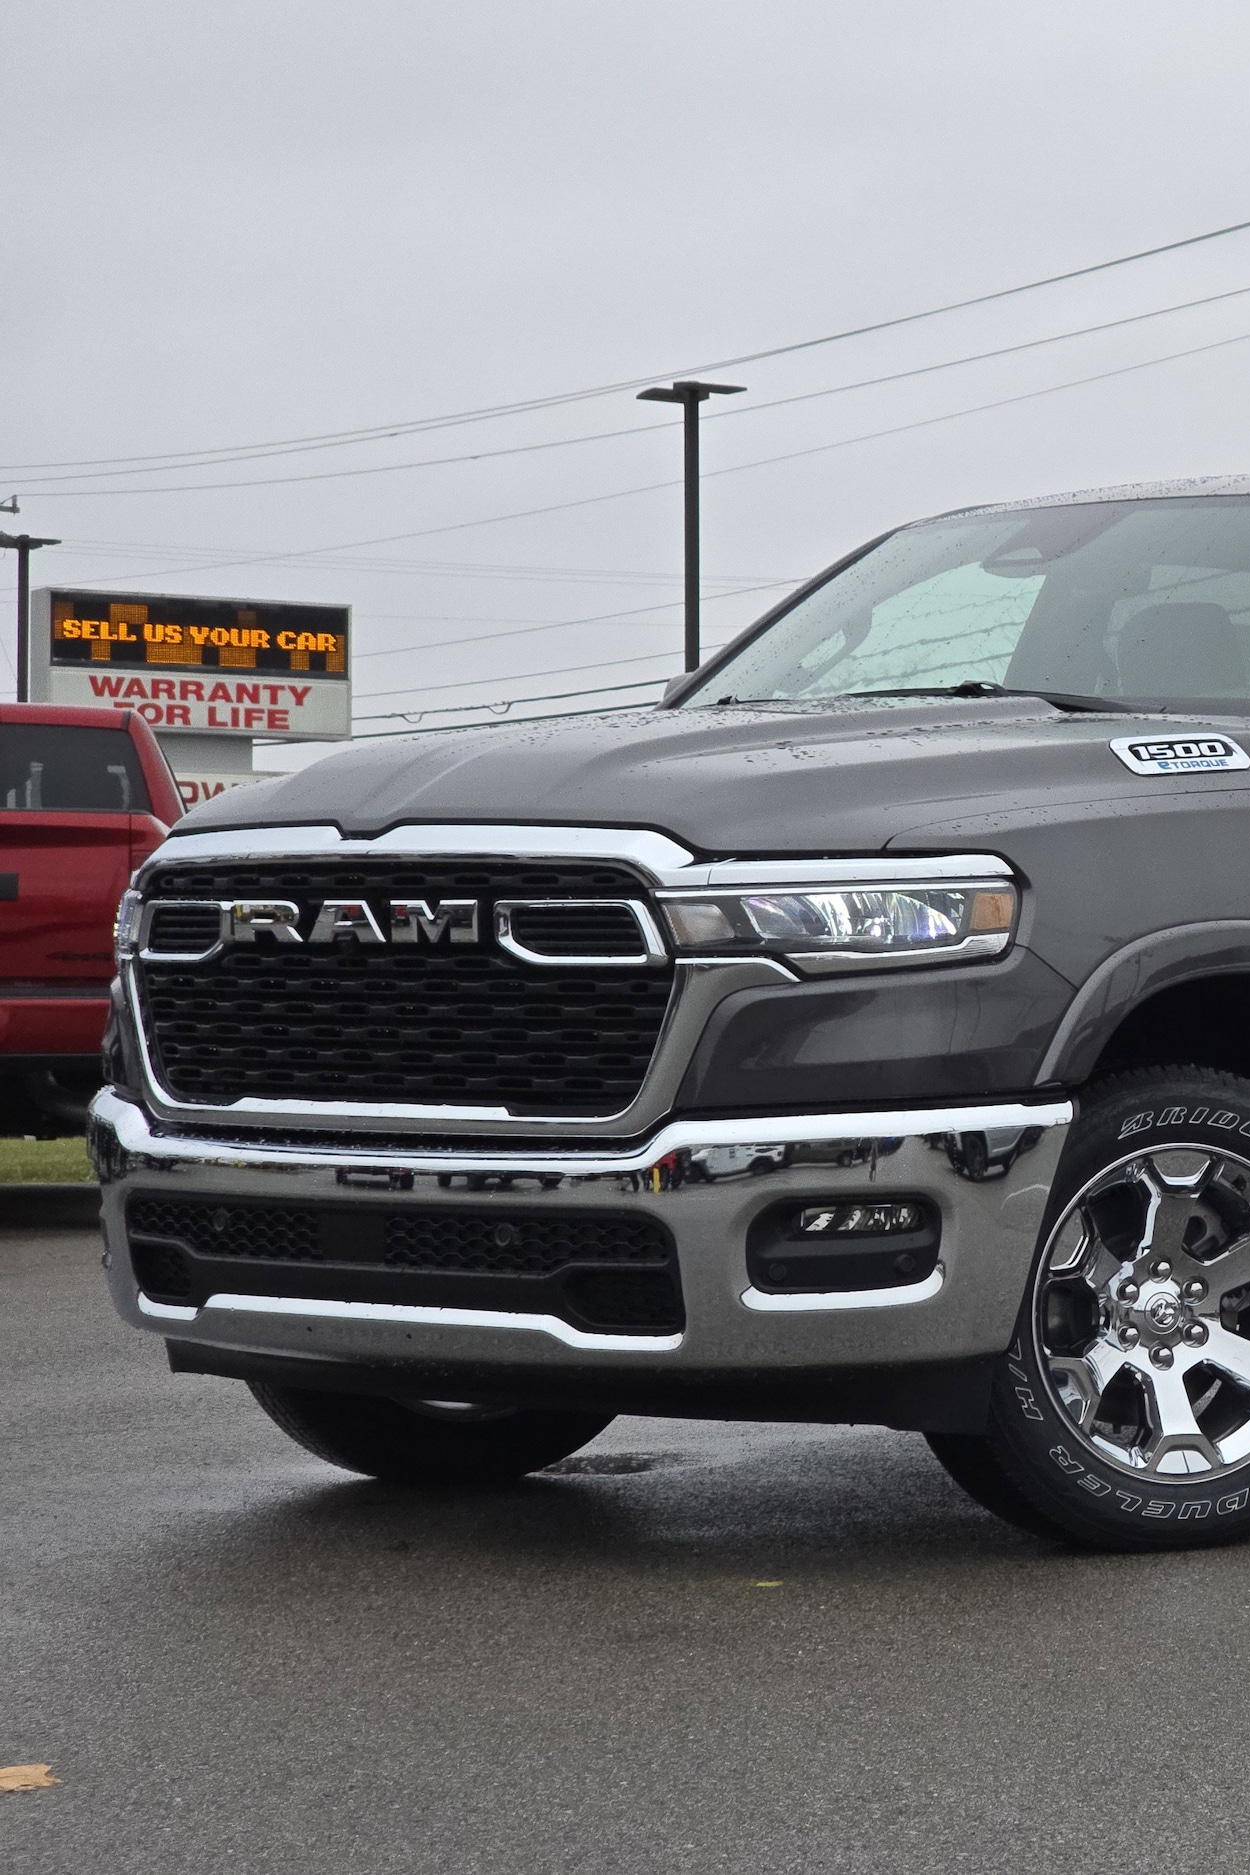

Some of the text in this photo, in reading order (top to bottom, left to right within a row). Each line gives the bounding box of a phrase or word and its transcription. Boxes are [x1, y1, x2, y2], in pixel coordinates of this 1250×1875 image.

[63, 619, 337, 652] SELL US YOUR CAR
[89, 675, 313, 706] WARRANTY
[208, 706, 290, 731] LIFE
[1133, 742, 1226, 759] 1500
[232, 899, 480, 943] RAM
[1049, 1445, 1250, 1520] DUELER
